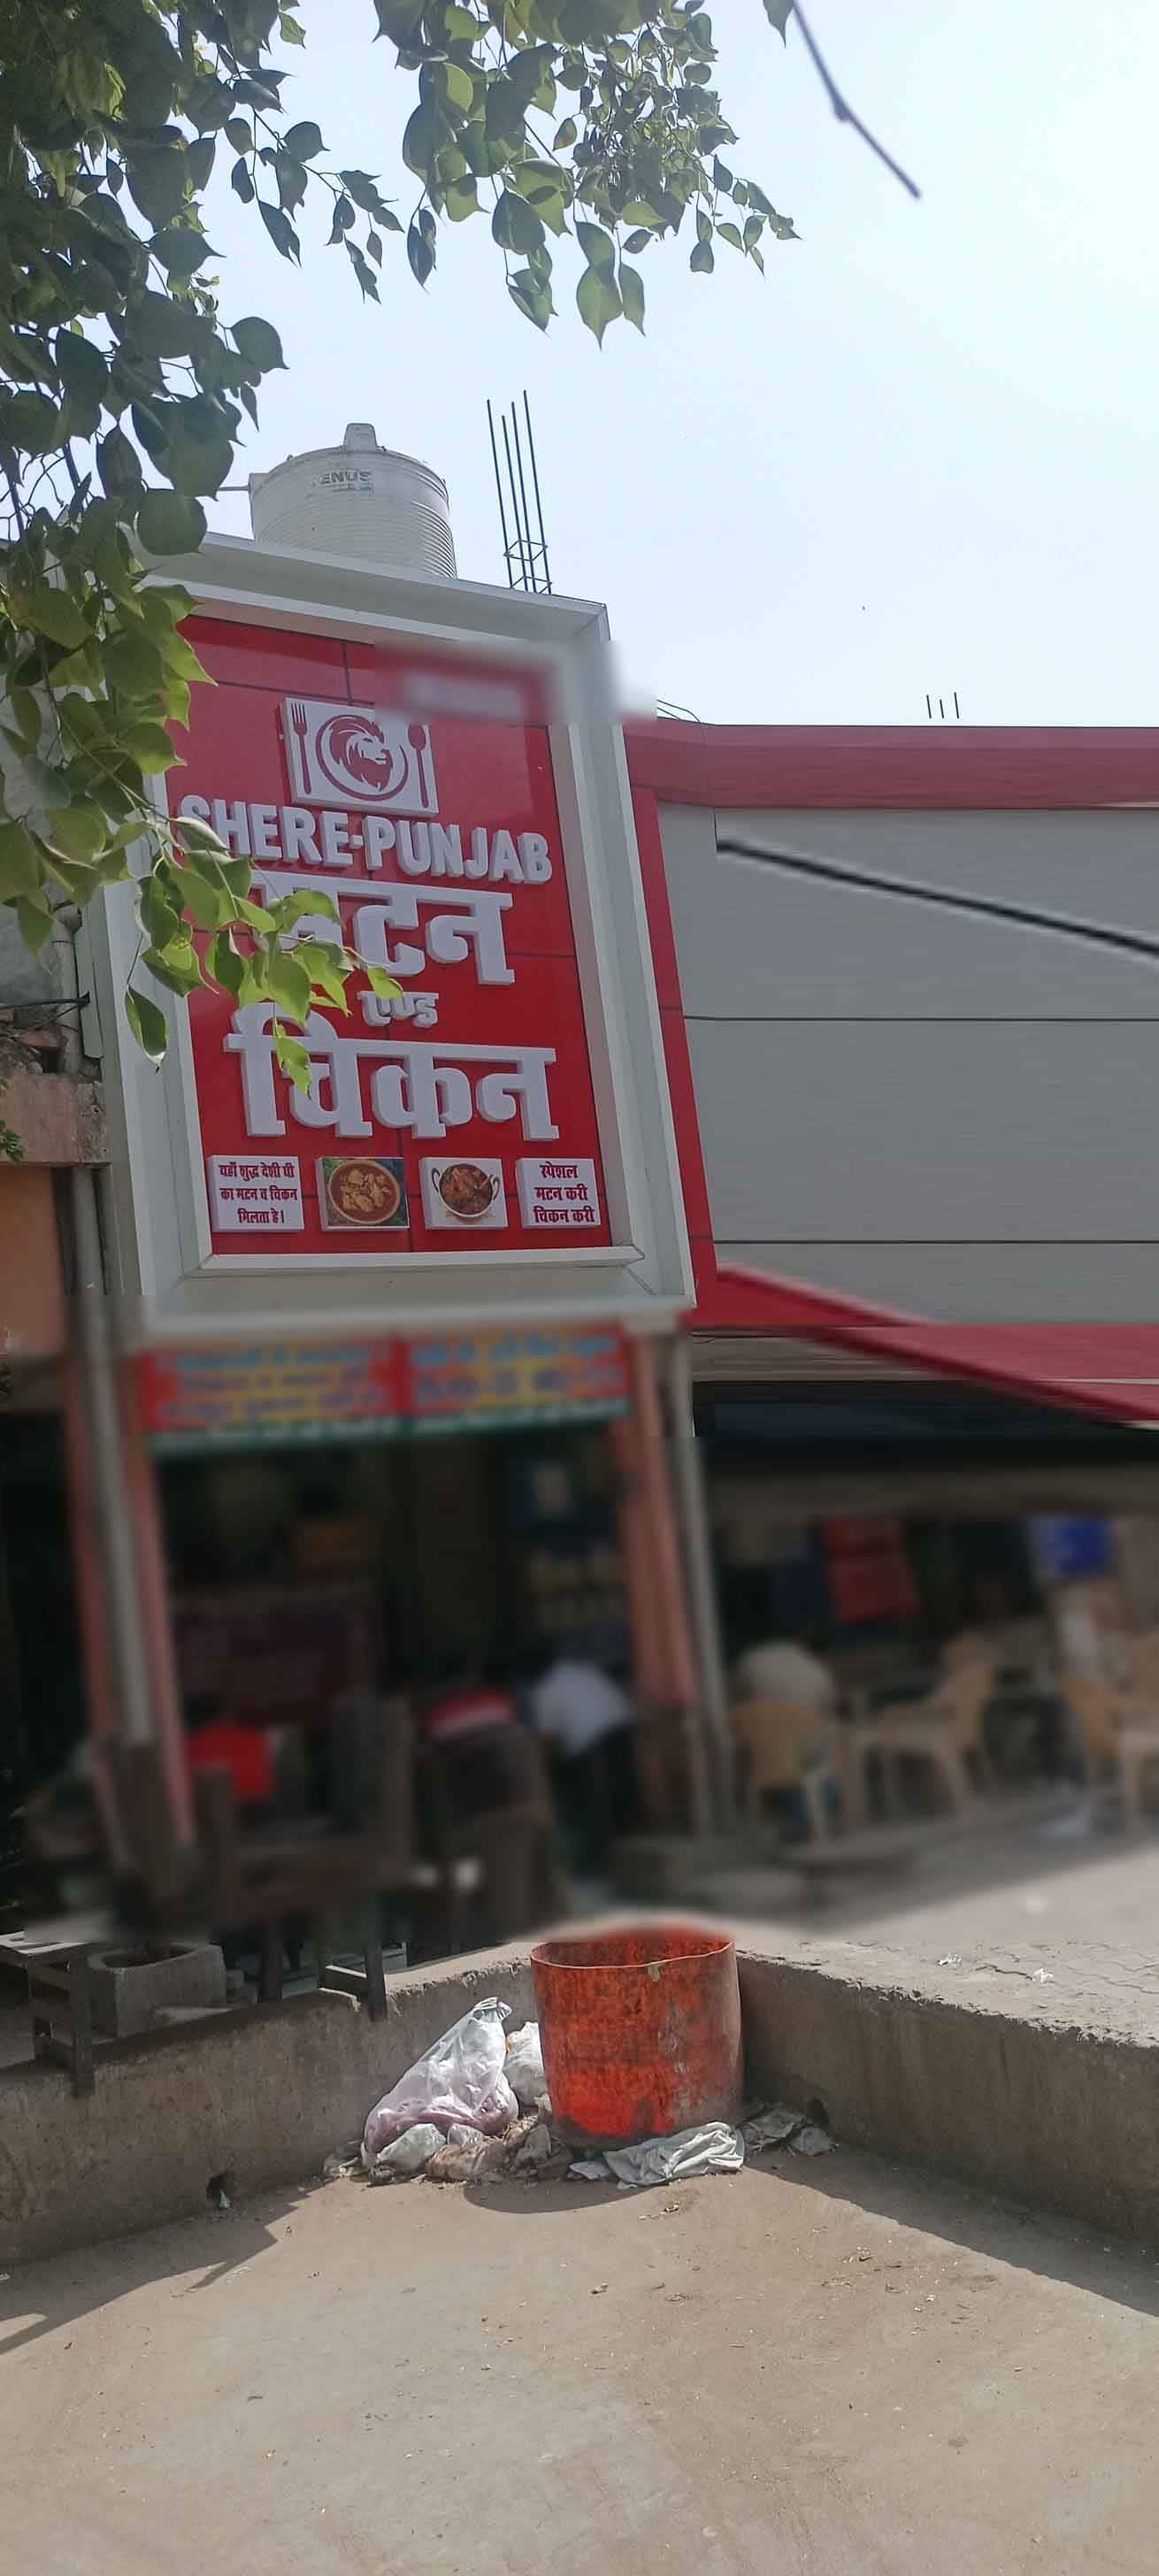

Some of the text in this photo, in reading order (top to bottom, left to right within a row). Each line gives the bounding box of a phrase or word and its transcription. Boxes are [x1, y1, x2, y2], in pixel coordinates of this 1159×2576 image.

[223, 1001, 559, 1140] चिकन
[539, 1161, 578, 1178] स्पेशल
[219, 1187, 234, 1200] का
[235, 1188, 257, 1200] मटन
[269, 1184, 298, 1200] चिकन
[534, 1183, 587, 1200] मटन करी
[238, 1208, 270, 1223] मिलता
[533, 1205, 595, 1223] चिकन करी
